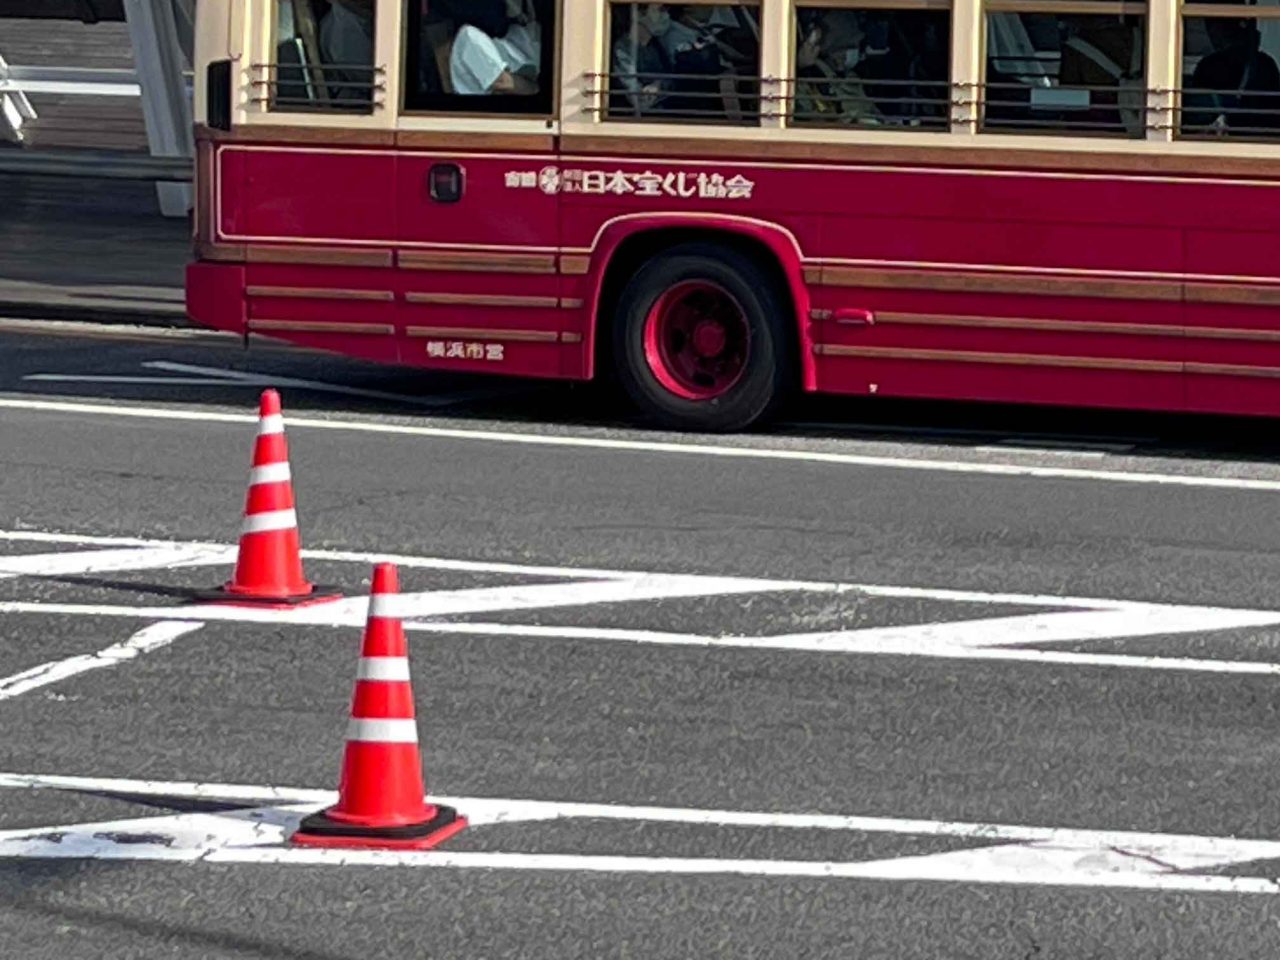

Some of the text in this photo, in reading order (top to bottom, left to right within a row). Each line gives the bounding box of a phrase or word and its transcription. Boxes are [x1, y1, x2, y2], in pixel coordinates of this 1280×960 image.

[583, 170, 754, 198] 日本宝くじ協会
